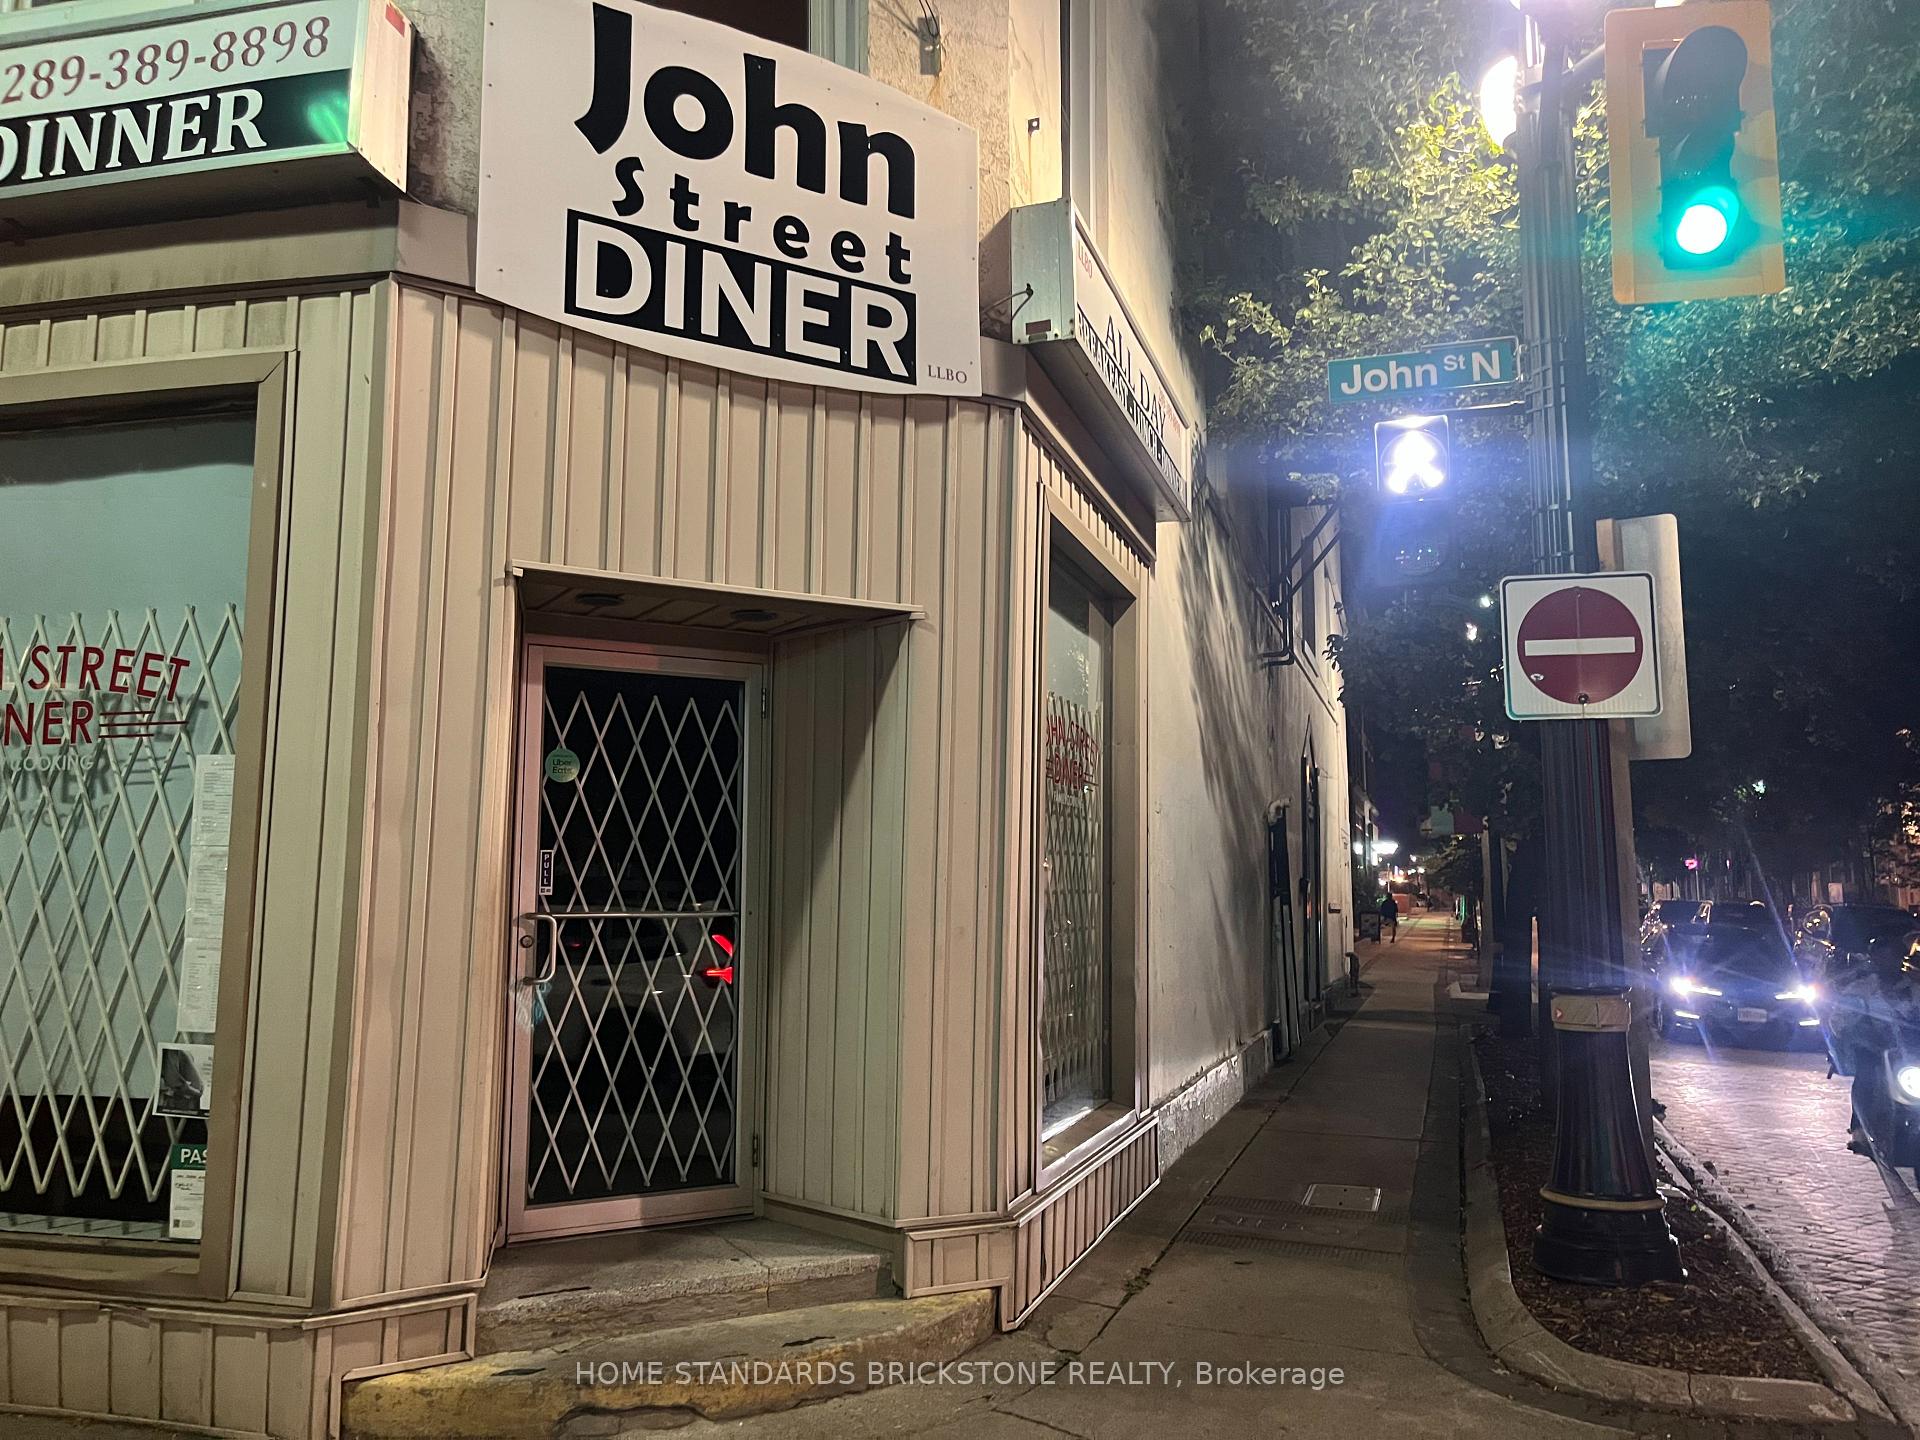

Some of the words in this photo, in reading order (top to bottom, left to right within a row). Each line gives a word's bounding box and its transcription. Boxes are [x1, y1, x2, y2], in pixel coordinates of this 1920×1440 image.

[3, 16, 331, 102] 289-389-8898
[574, 2, 915, 219] John
[612, 157, 911, 285] Street
[574, 218, 909, 377] DINER
[927, 364, 968, 385] LLBO
[1105, 315, 1136, 394] ALL
[1140, 368, 1166, 442] DAY
[1341, 361, 1438, 395] John
[1443, 354, 1466, 371] St
[1471, 350, 1501, 382] N
[28, 645, 190, 702] STREET
